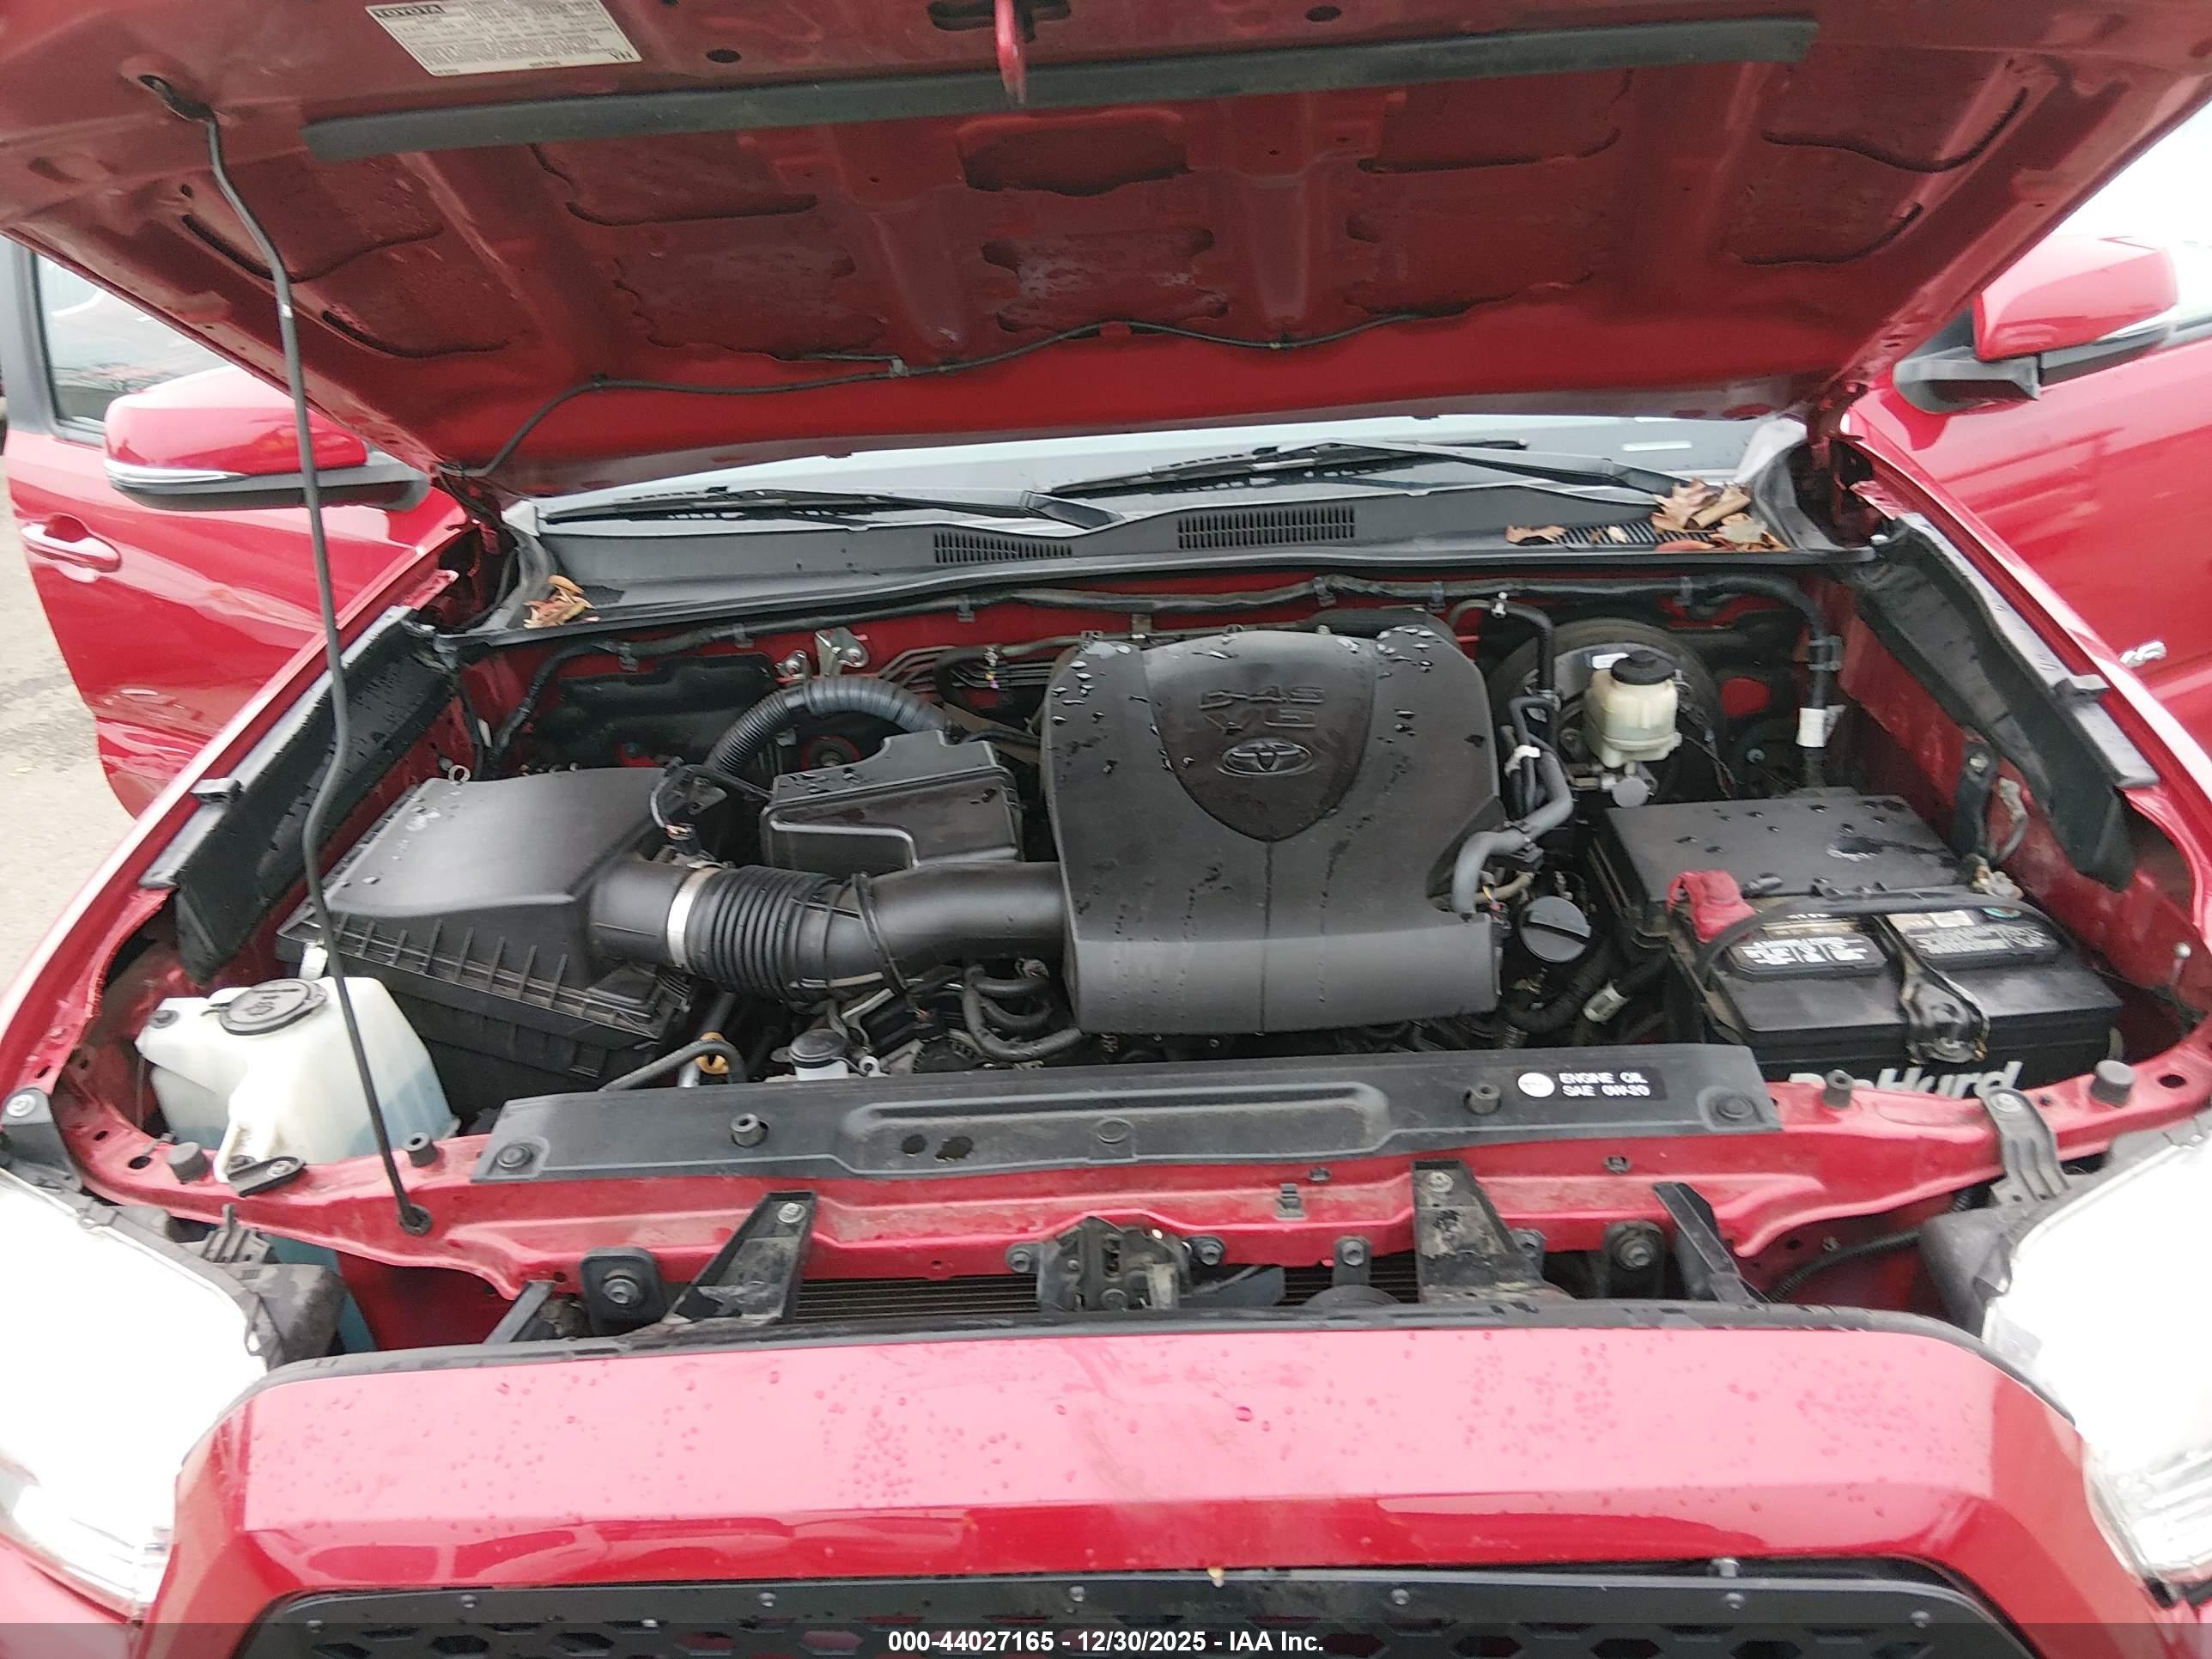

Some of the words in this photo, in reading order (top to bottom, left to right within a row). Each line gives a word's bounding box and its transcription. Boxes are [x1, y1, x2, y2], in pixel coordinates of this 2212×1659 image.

[1559, 1073, 1615, 1084] ENGINE
[1620, 1072, 1649, 1084] OIL
[1562, 1085, 1597, 1097] SAE
[1601, 1085, 1651, 1097] 0W-20
